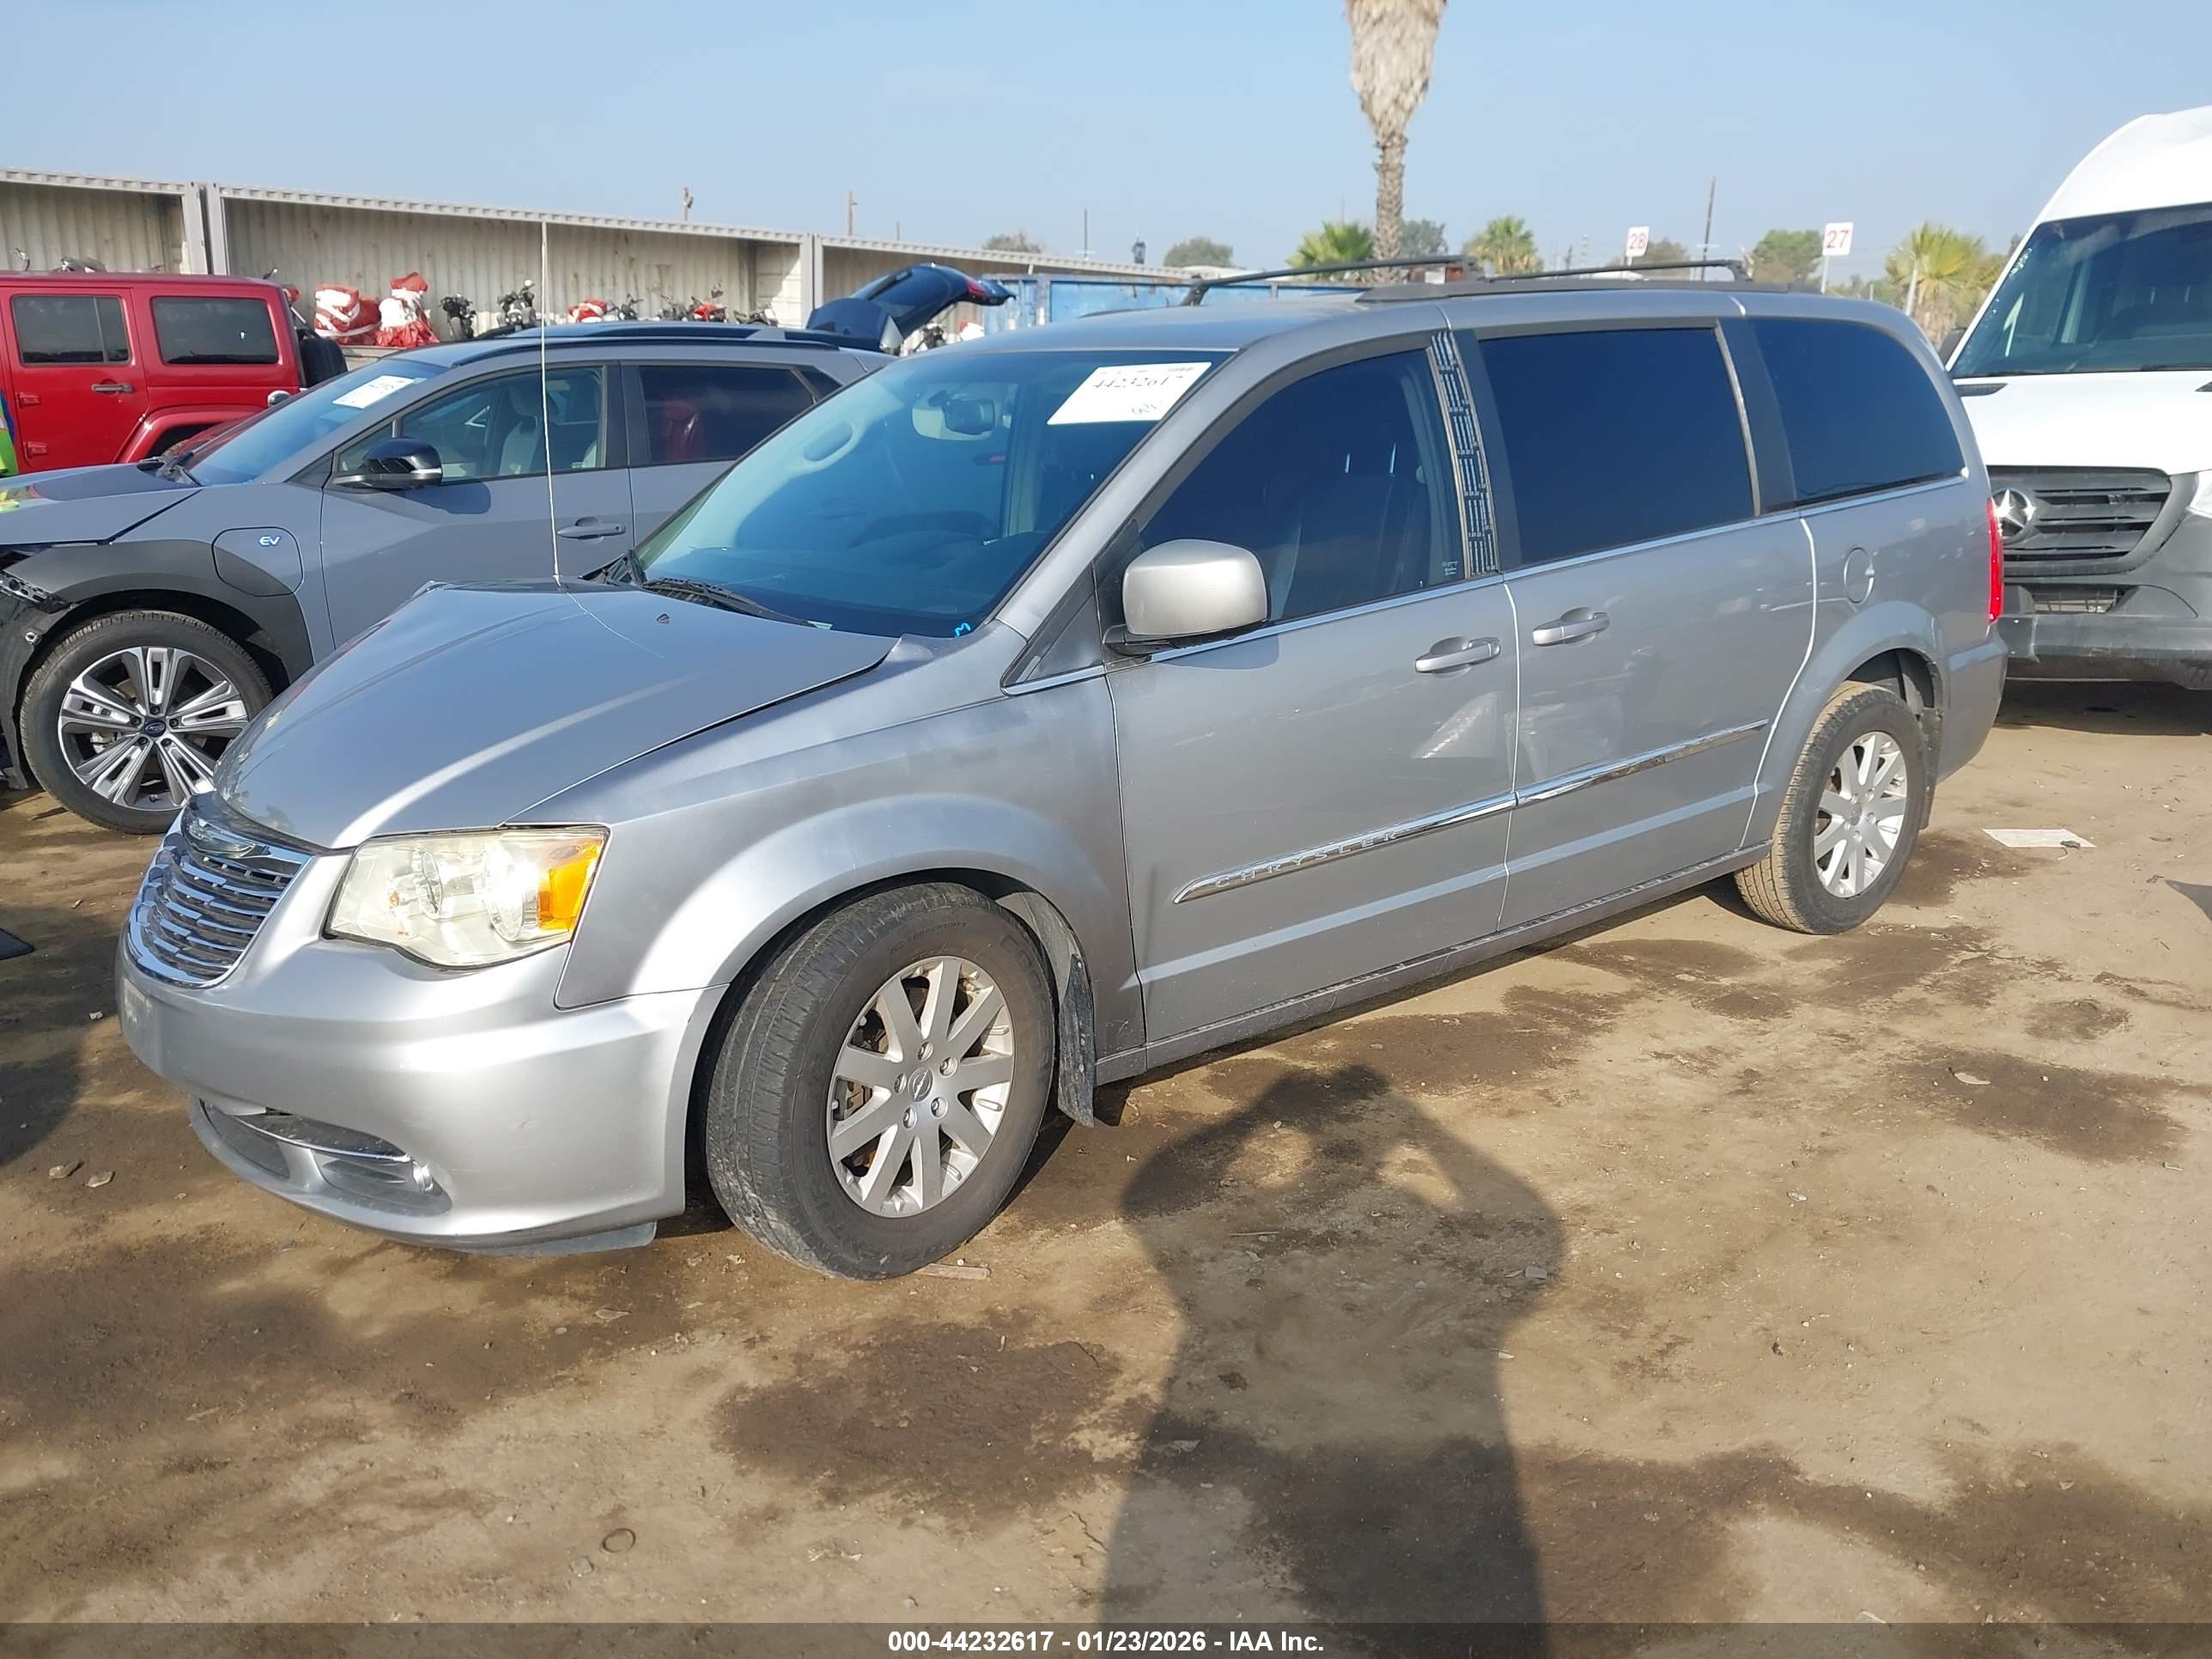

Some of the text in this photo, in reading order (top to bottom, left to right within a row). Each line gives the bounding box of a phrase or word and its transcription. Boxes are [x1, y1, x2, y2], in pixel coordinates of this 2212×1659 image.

[1630, 233, 1647, 249] 28
[1826, 229, 1849, 248] 27
[259, 536, 281, 546] EV
[1215, 831, 1397, 888] CHRYSLER
